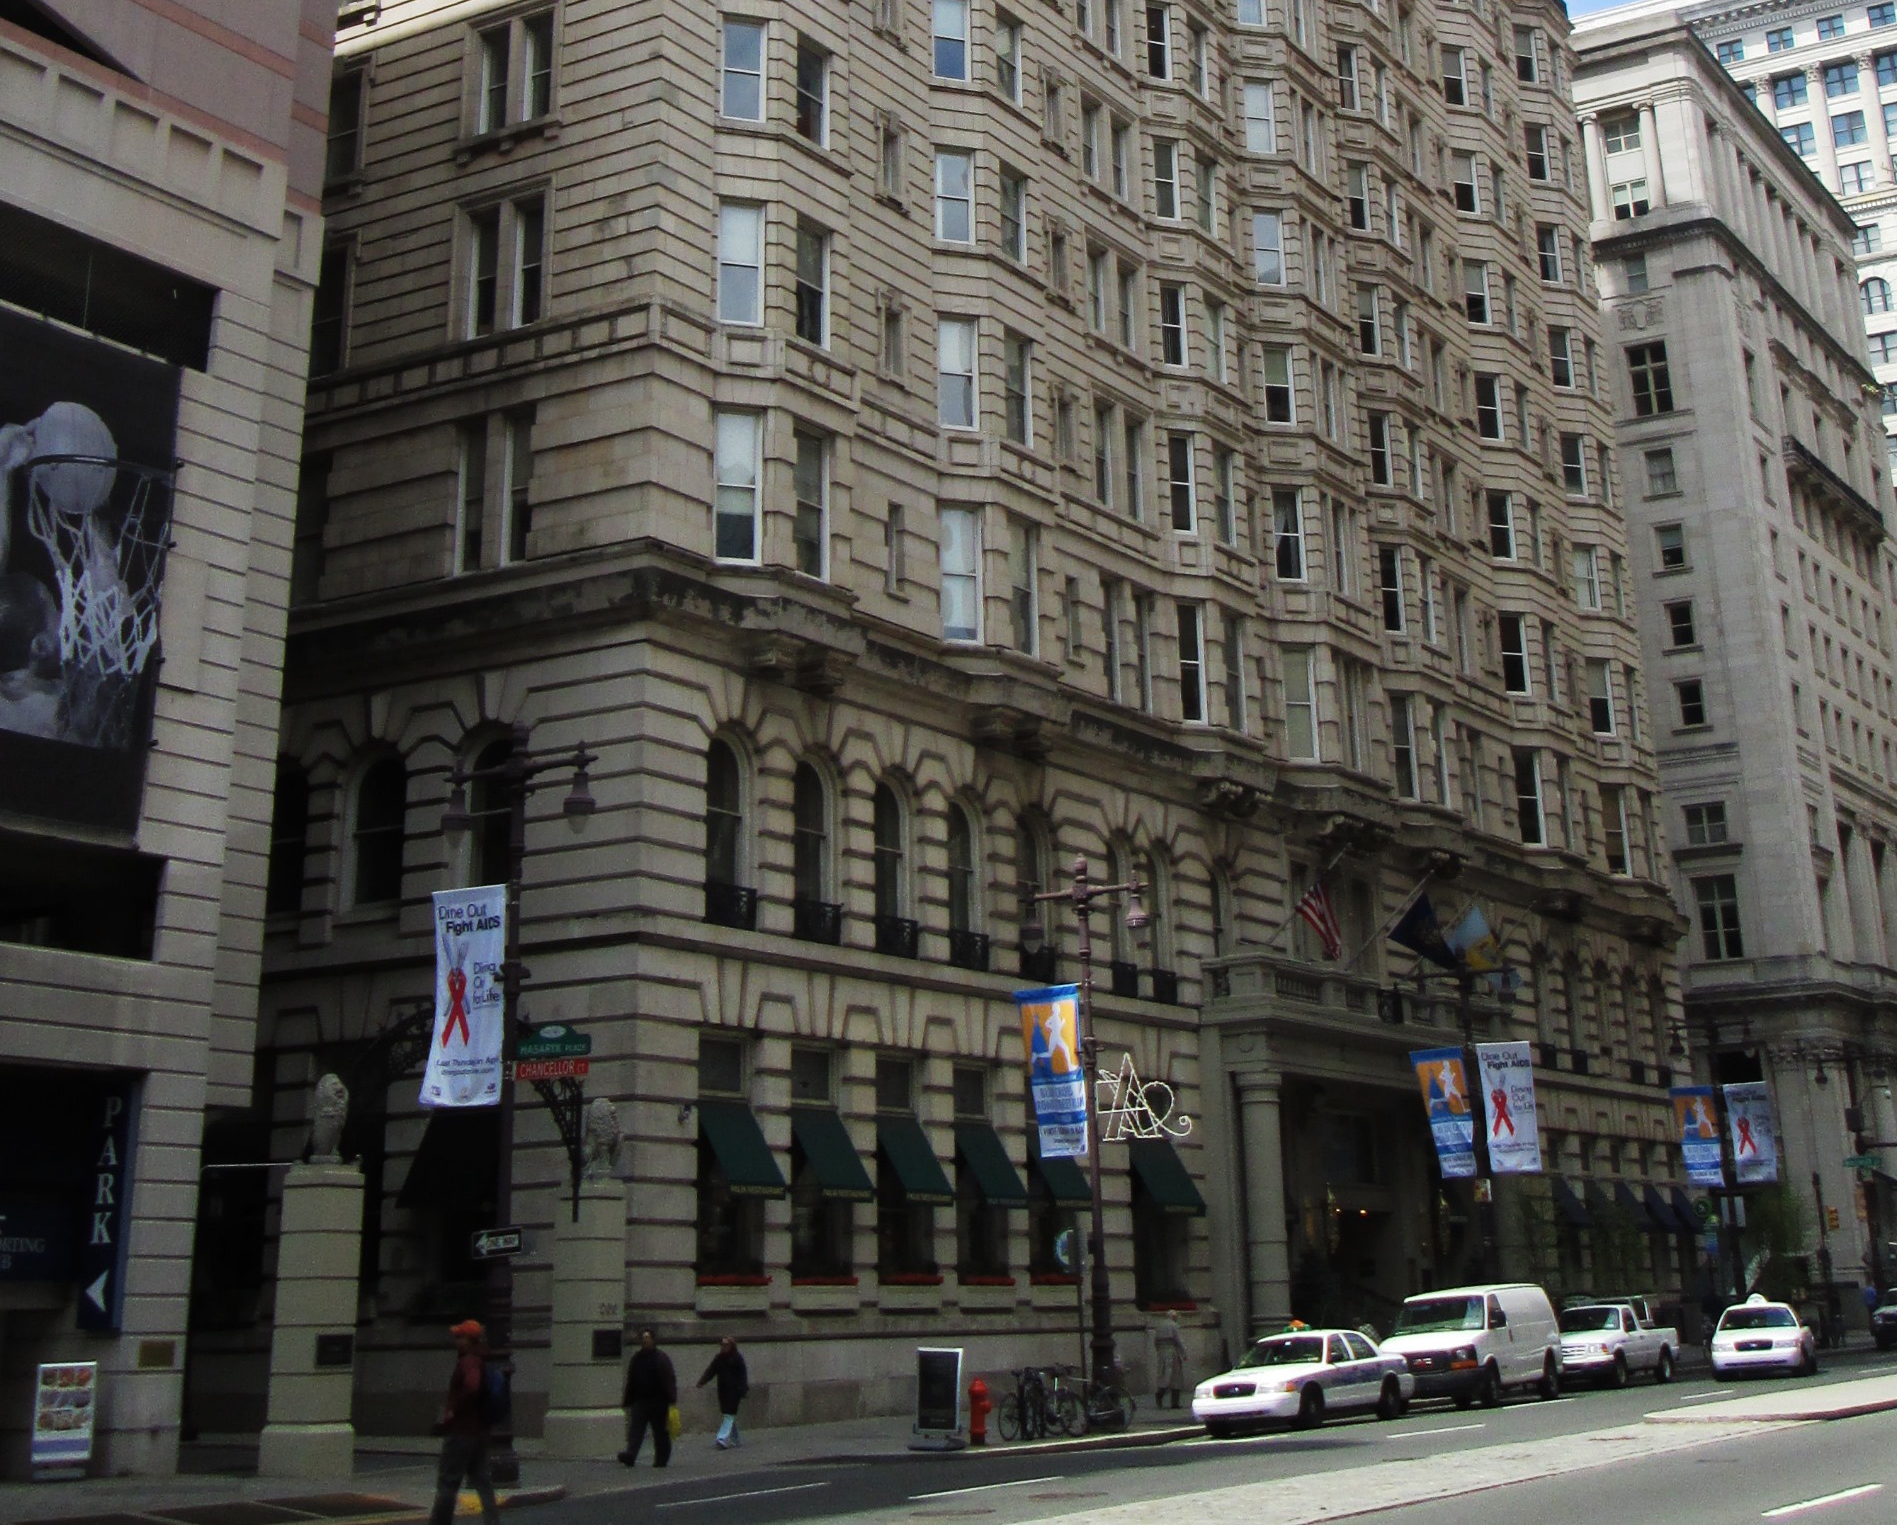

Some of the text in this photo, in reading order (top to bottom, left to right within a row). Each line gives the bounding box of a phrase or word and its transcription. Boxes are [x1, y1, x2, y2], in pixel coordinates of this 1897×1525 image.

[438, 903, 487, 920] Dine Out
[446, 915, 501, 936] Fight AIDS
[520, 1060, 586, 1078] CHANCELLOR CT
[1487, 1059, 1530, 1070] Fight AIDS
[90, 1096, 122, 1244] PARK
